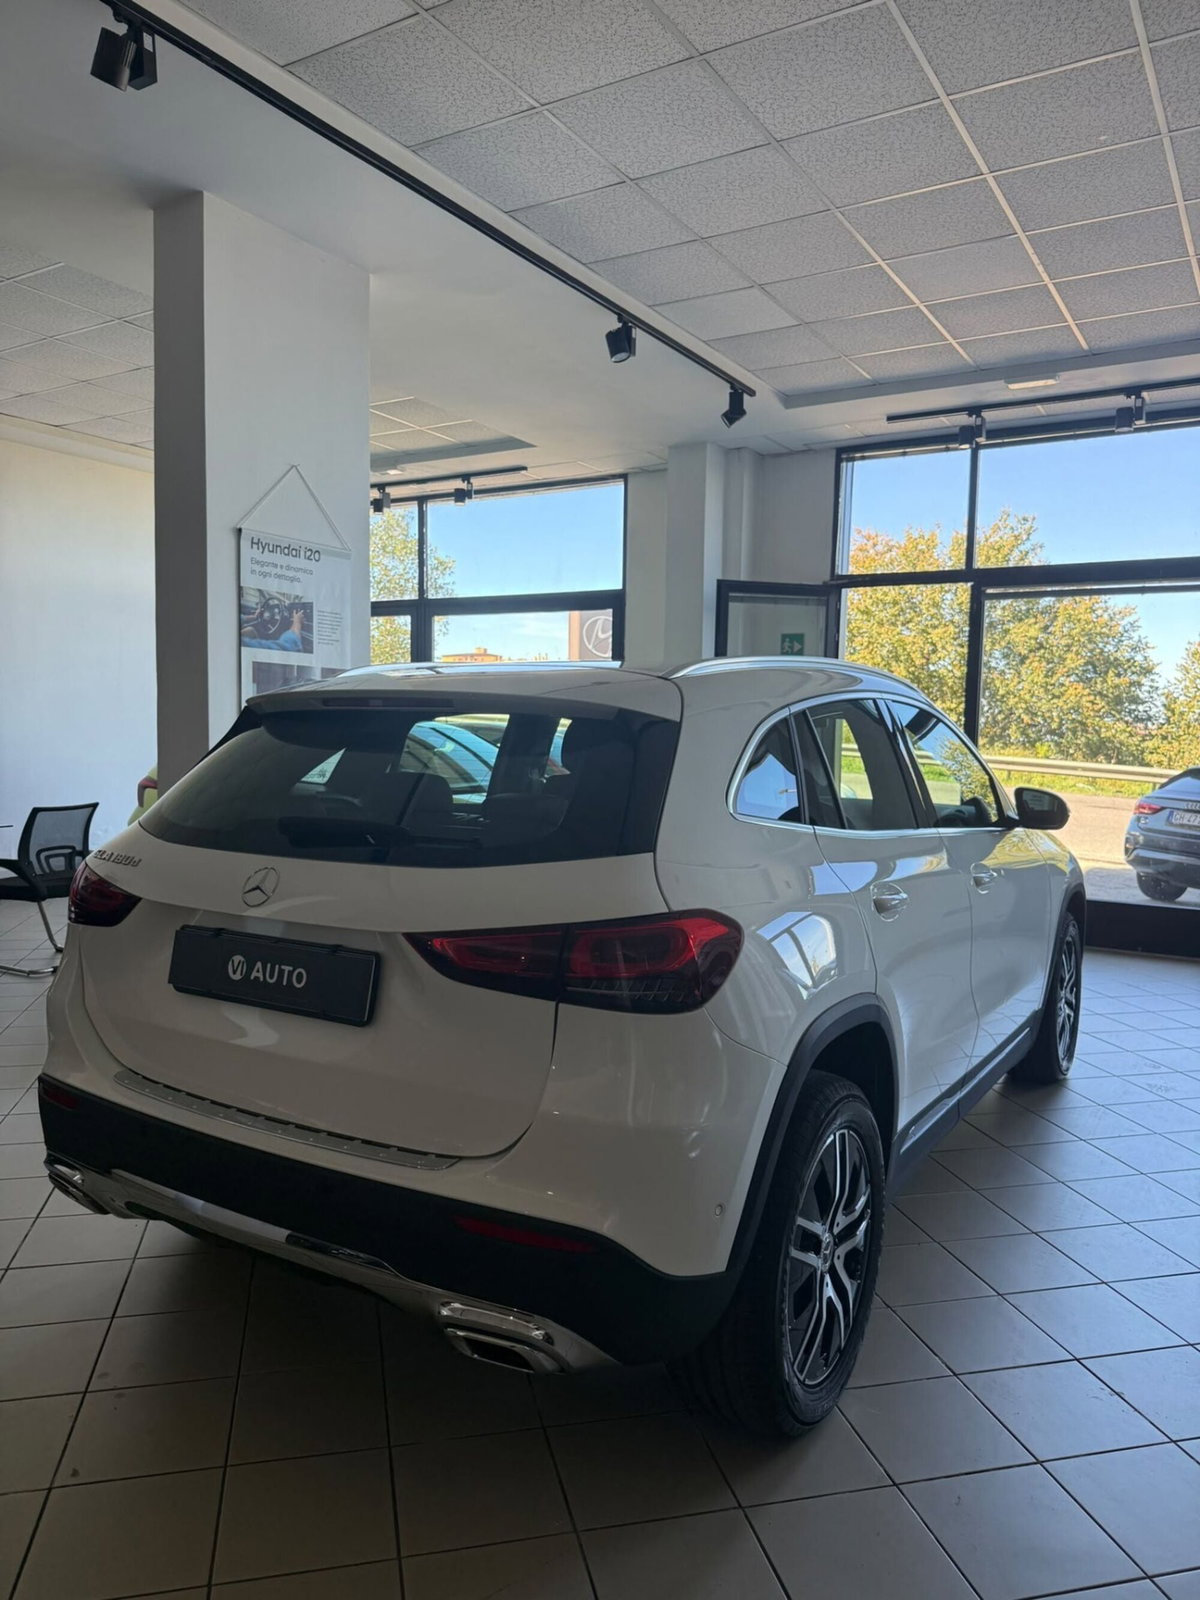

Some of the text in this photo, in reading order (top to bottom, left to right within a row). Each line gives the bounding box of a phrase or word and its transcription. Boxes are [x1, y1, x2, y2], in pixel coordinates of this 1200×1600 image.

[250, 536, 321, 562] Hyundai i20
[250, 960, 307, 988] AUTO
